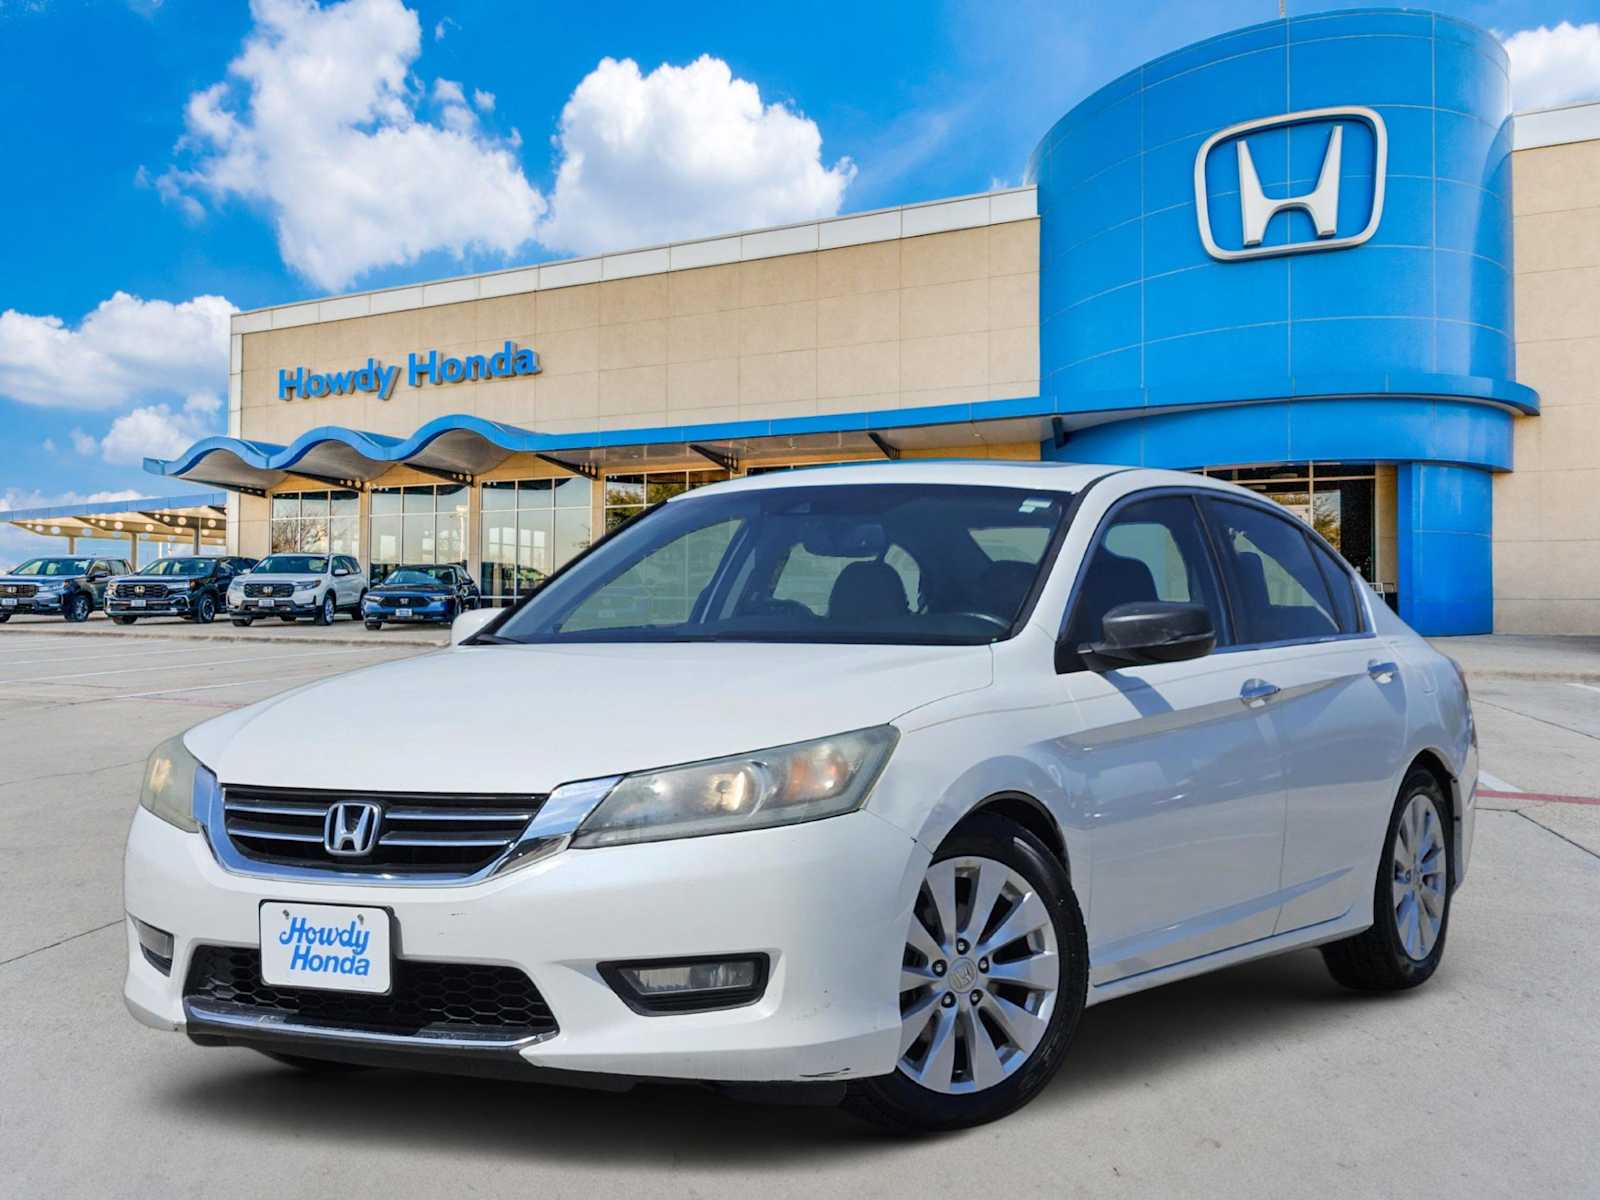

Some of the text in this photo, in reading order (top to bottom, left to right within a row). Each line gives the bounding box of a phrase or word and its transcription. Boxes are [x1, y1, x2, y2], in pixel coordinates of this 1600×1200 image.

[278, 340, 542, 401] Howdy Honda
[279, 916, 370, 955] Howdy
[290, 945, 370, 976] Honda
